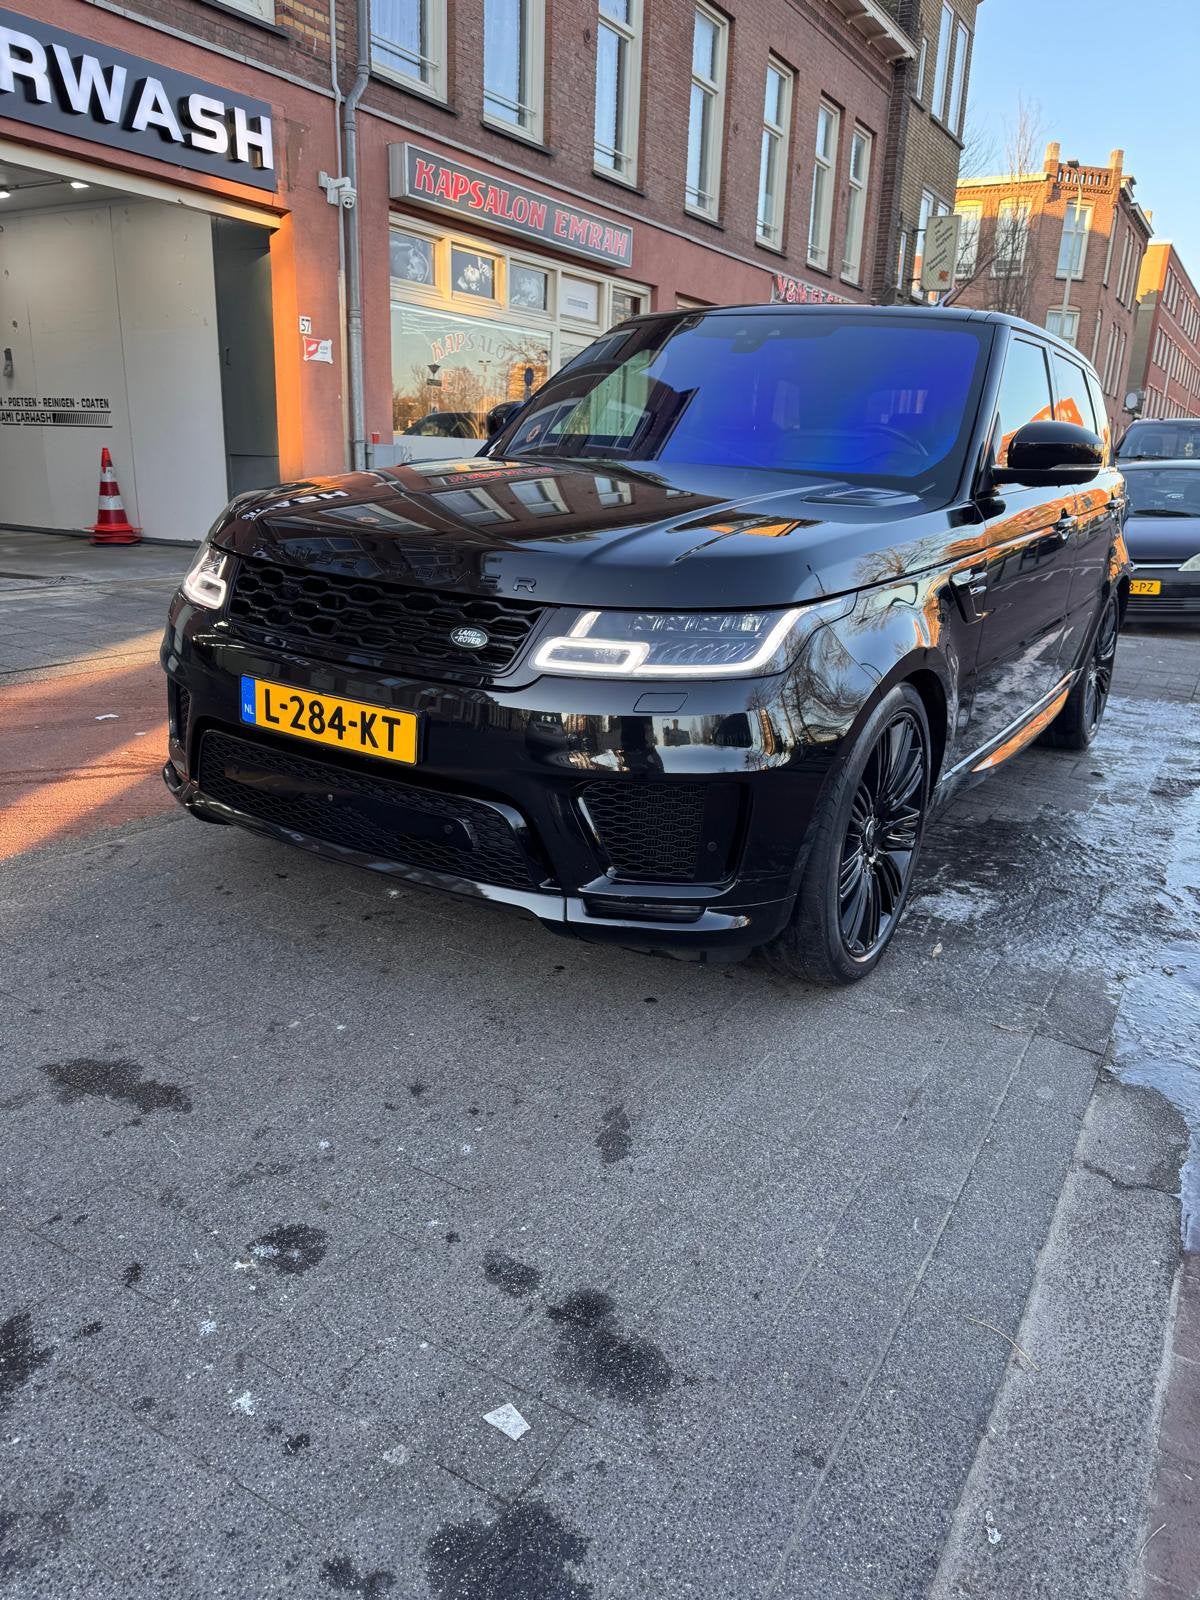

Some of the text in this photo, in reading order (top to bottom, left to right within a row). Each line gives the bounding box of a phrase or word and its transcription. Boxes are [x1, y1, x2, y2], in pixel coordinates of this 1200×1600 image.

[415, 157, 629, 258] KAPSALON EMRAH
[301, 318, 311, 332] 57
[431, 331, 511, 364] KAPSALO
[8, 397, 37, 407] POETSEN
[42, 397, 75, 408] REINIGEN
[81, 398, 110, 409] COATEN
[0, 411, 52, 423] AMI CARWASH
[457, 629, 478, 637] LAND
[457, 635, 481, 645] ROVER
[243, 687, 401, 753] NL L-284-KT
